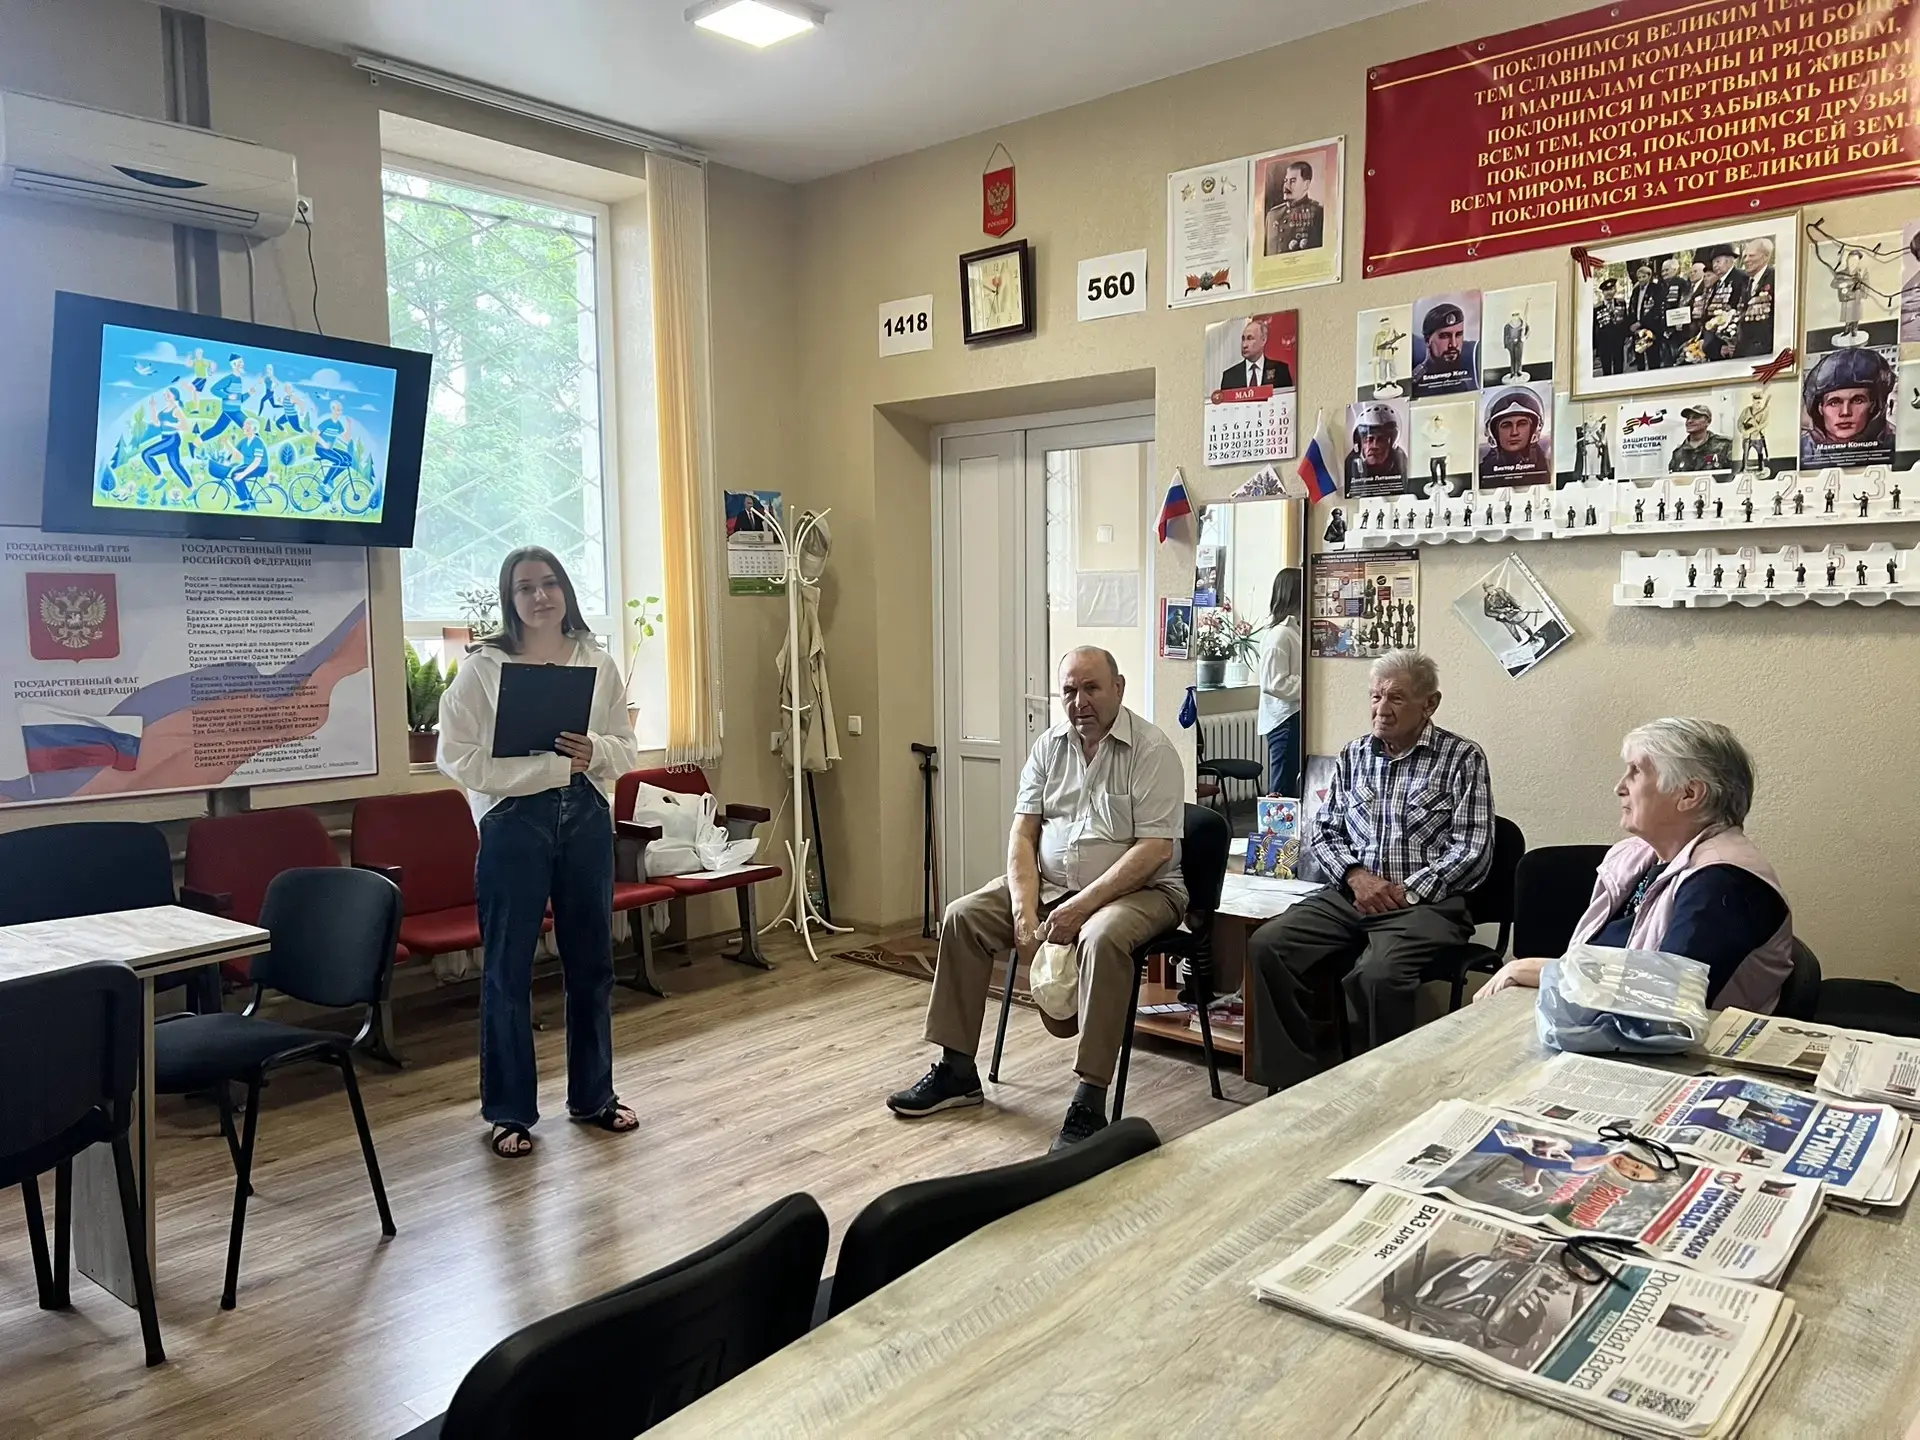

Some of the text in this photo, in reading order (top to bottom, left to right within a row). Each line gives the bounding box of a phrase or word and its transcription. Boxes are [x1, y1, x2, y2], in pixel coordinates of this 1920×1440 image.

[1492, 29, 1638, 80] ПОКЛОНИМСЯ
[1647, 0, 1756, 42] ВЕЛИКИМ
[1475, 82, 1512, 106] ТЕМ
[1518, 55, 1624, 96] СЛАВНЫМ
[1632, 15, 1790, 71] КОМАНДИРАМ
[1800, 10, 1814, 29] И
[1501, 14, 1901, 121] И МАРШАЛАМ СТРАНЫ И РЯДОВЫМ,
[1487, 97, 1632, 144] ПОКЛОНИМСЯ
[1640, 93, 1652, 111] И
[1661, 65, 1777, 106] МЕРТВЫМ
[1785, 60, 1800, 79] И
[1477, 142, 1529, 168] ВСЕМ
[1536, 130, 1583, 157] ТЕМ,
[1588, 107, 1693, 144] КОТОРЫХ
[1700, 79, 1820, 121] ЗАБЫВАТЬ
[1487, 141, 1636, 188] ПОКЛОНИМСЯ,
[1643, 105, 1810, 155] ПОКЛОНИМСЯ
[1450, 107, 1920, 214] ВСЕМ МИРОМ, ВСЕМ НАРОДОМ, ВСЕЙ ЗЕМЛ
[1491, 131, 1905, 227] ПОКЛОНИМСЯ ЗА ТОТ ВЕЛИКИЙ БОЙ.
[1088, 272, 1135, 301] 560
[884, 312, 928, 337] 1418
[1423, 372, 1451, 381] Владимир
[1235, 389, 1254, 399] МАЙ
[1210, 424, 1216, 433] 4
[1222, 423, 1228, 431] 5
[1233, 422, 1239, 430] 6
[1245, 421, 1250, 429] 7
[1257, 419, 1262, 427] 8
[1269, 418, 1274, 426] 9
[1258, 408, 1287, 418] 1 2 3
[1209, 427, 1288, 442] 11 12 13 14 15 16 17
[1209, 436, 1288, 451] 18 19 20 21 22 23 24
[1622, 435, 1667, 443] ЗАЩИТНИКИ
[1816, 440, 1878, 450] Максим Концов
[1208, 446, 1288, 461] 25 26 27 28 29 30 31
[1493, 463, 1535, 472] Виктор Дудин
[5, 552, 131, 564] РОССИЙСКОЙ ФЕДЕРАЦИИ
[6, 542, 130, 553] ГОСУДАРСТВЕННЫЙ ГЕРБ
[181, 543, 312, 555] ГОСУДАРСТВЕННЫЙ ГИМН
[181, 554, 312, 567] РОССИЙСКОЙ ФЕДЕРАЦИИ
[14, 676, 139, 689] ГОСУДАРСТВЕННЫЙ ФЛАГ
[14, 686, 140, 699] РОССИЙСКОЙ ФЕДЕРАЦИИ
[1795, 1110, 1853, 1170] ВЕСТНИК
[1834, 1113, 1877, 1172] Запорожский
[1677, 1187, 1724, 1229] ПРАВДА
[1374, 1204, 1439, 1261] ВАЗ для вас
[1681, 1188, 1744, 1260] КОМСОМОЛЬСКАЯ
[1606, 1270, 1680, 1353] Российская
[1571, 1344, 1626, 1391] Газета
